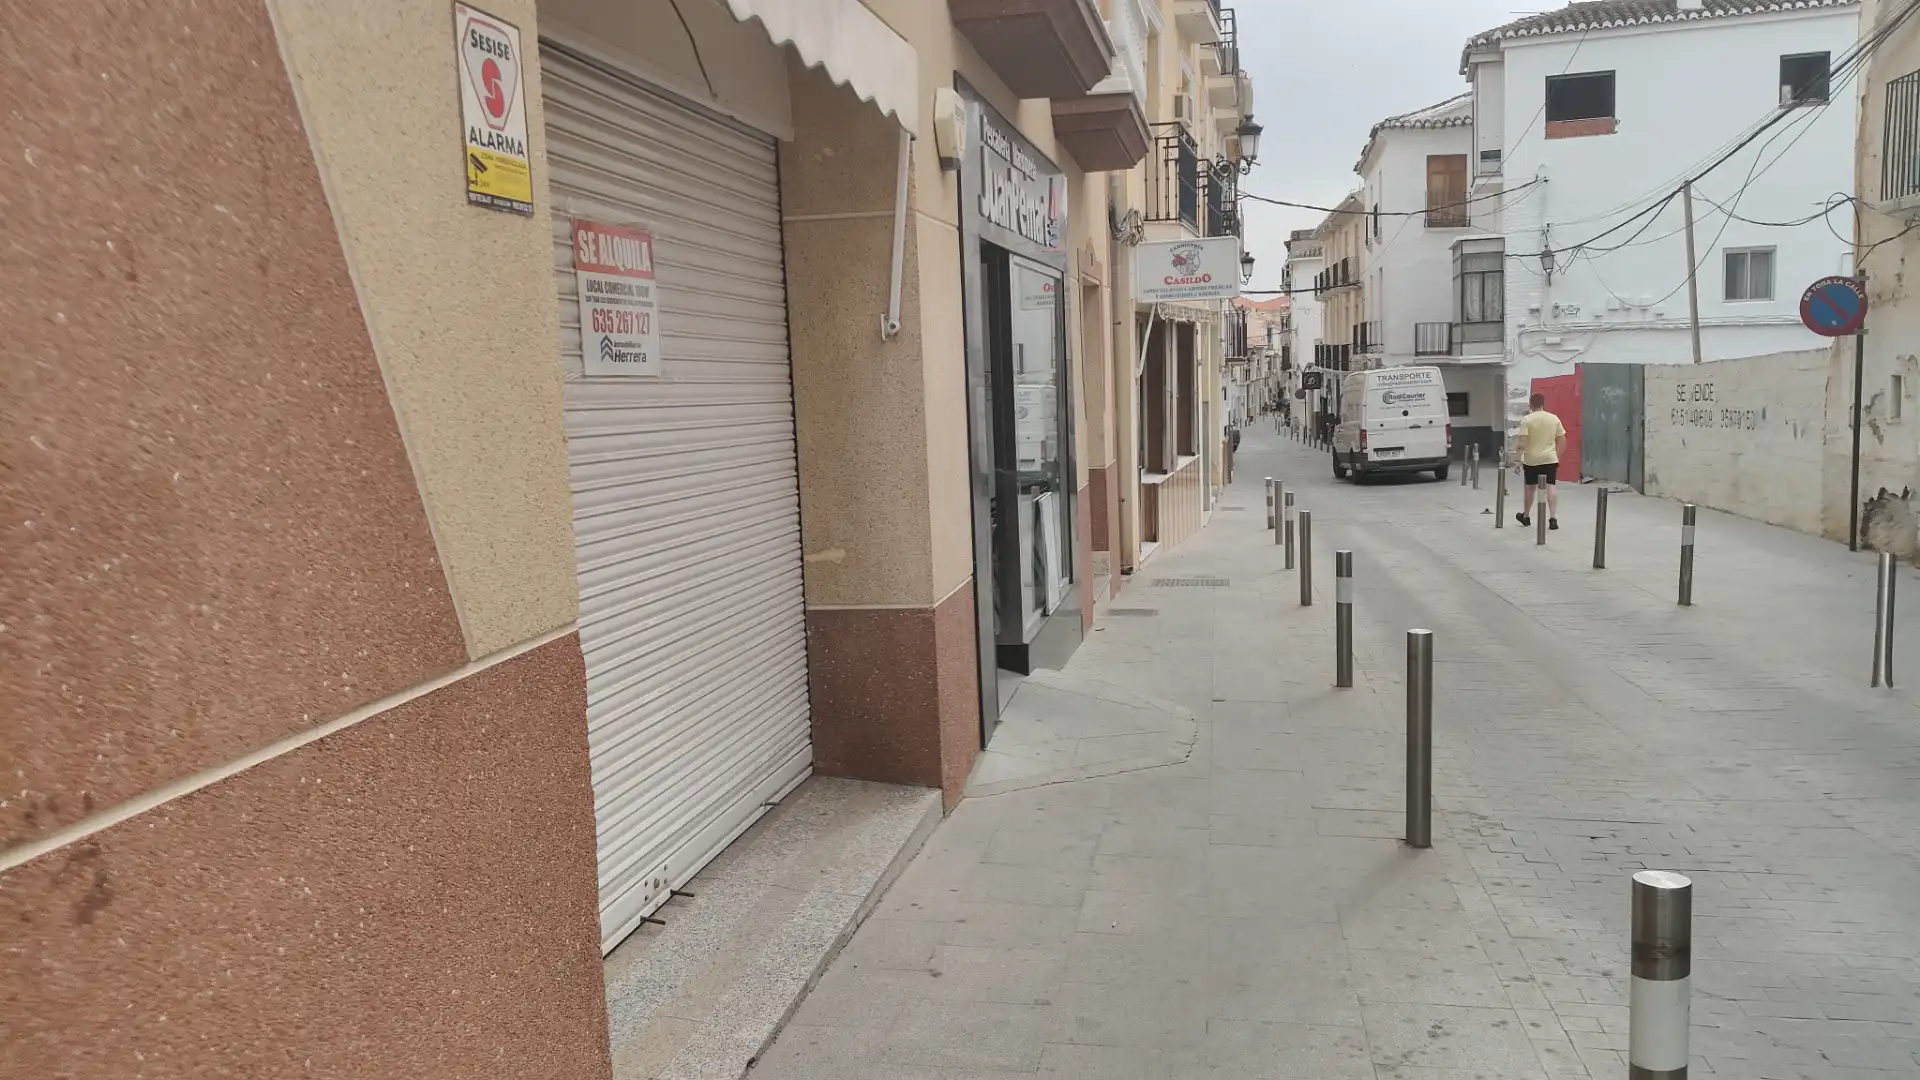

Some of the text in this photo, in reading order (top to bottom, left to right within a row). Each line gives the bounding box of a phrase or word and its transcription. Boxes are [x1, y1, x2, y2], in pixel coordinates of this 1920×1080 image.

[470, 28, 510, 61] SESISE
[469, 125, 526, 158] ALARMA
[578, 229, 652, 272] SE ALQUILA
[586, 278, 604, 293] LOCAL
[604, 280, 635, 297] COMERCIAL
[1164, 273, 1212, 285] CASILDO
[1804, 292, 1812, 301] EN
[1812, 280, 1832, 292] TODA
[1845, 281, 1864, 299] CALLE
[592, 307, 650, 336] 635 267 127
[614, 350, 647, 363] Herrera
[1377, 371, 1432, 382] TRANSPORTE
[1676, 384, 1687, 402] SE
